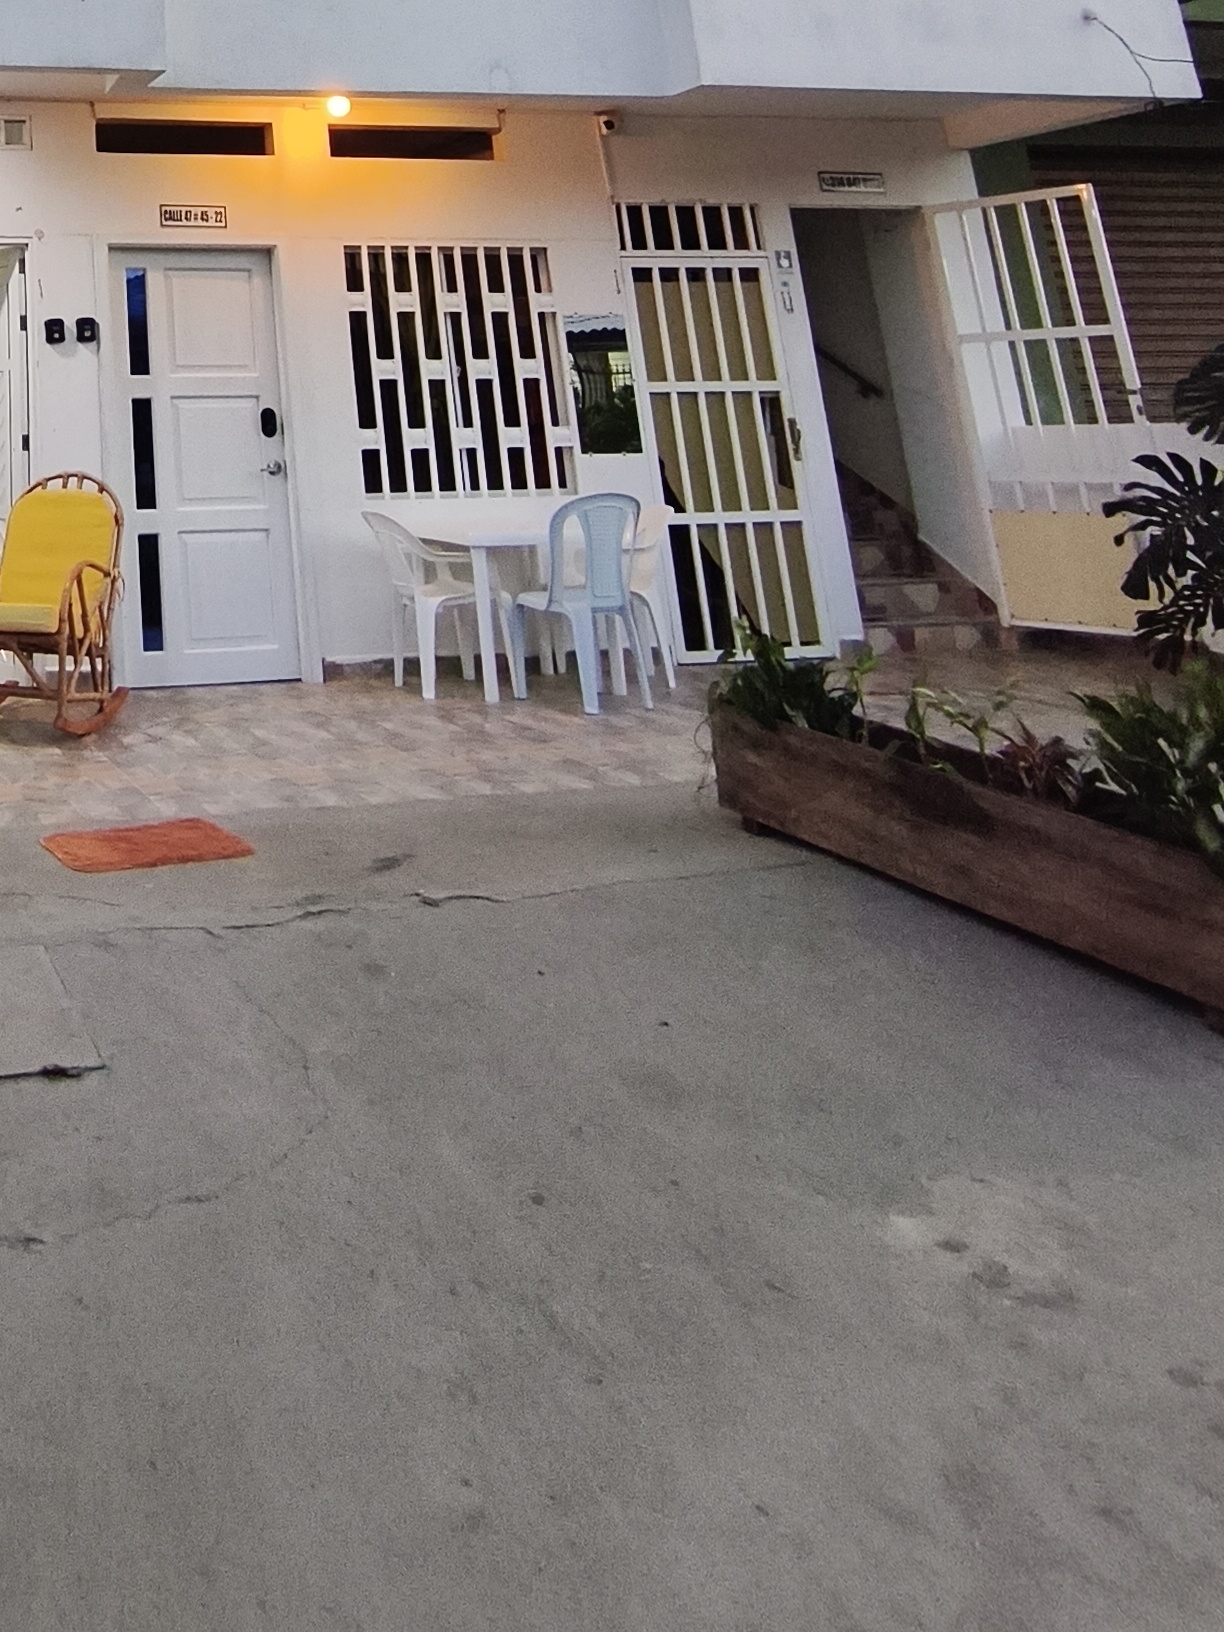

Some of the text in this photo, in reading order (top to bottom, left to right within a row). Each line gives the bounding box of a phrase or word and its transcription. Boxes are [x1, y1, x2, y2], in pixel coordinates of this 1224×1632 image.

[164, 210, 182, 222] CALLE
[184, 210, 192, 222] 47
[200, 211, 209, 223] 45
[214, 211, 223, 223] 22
